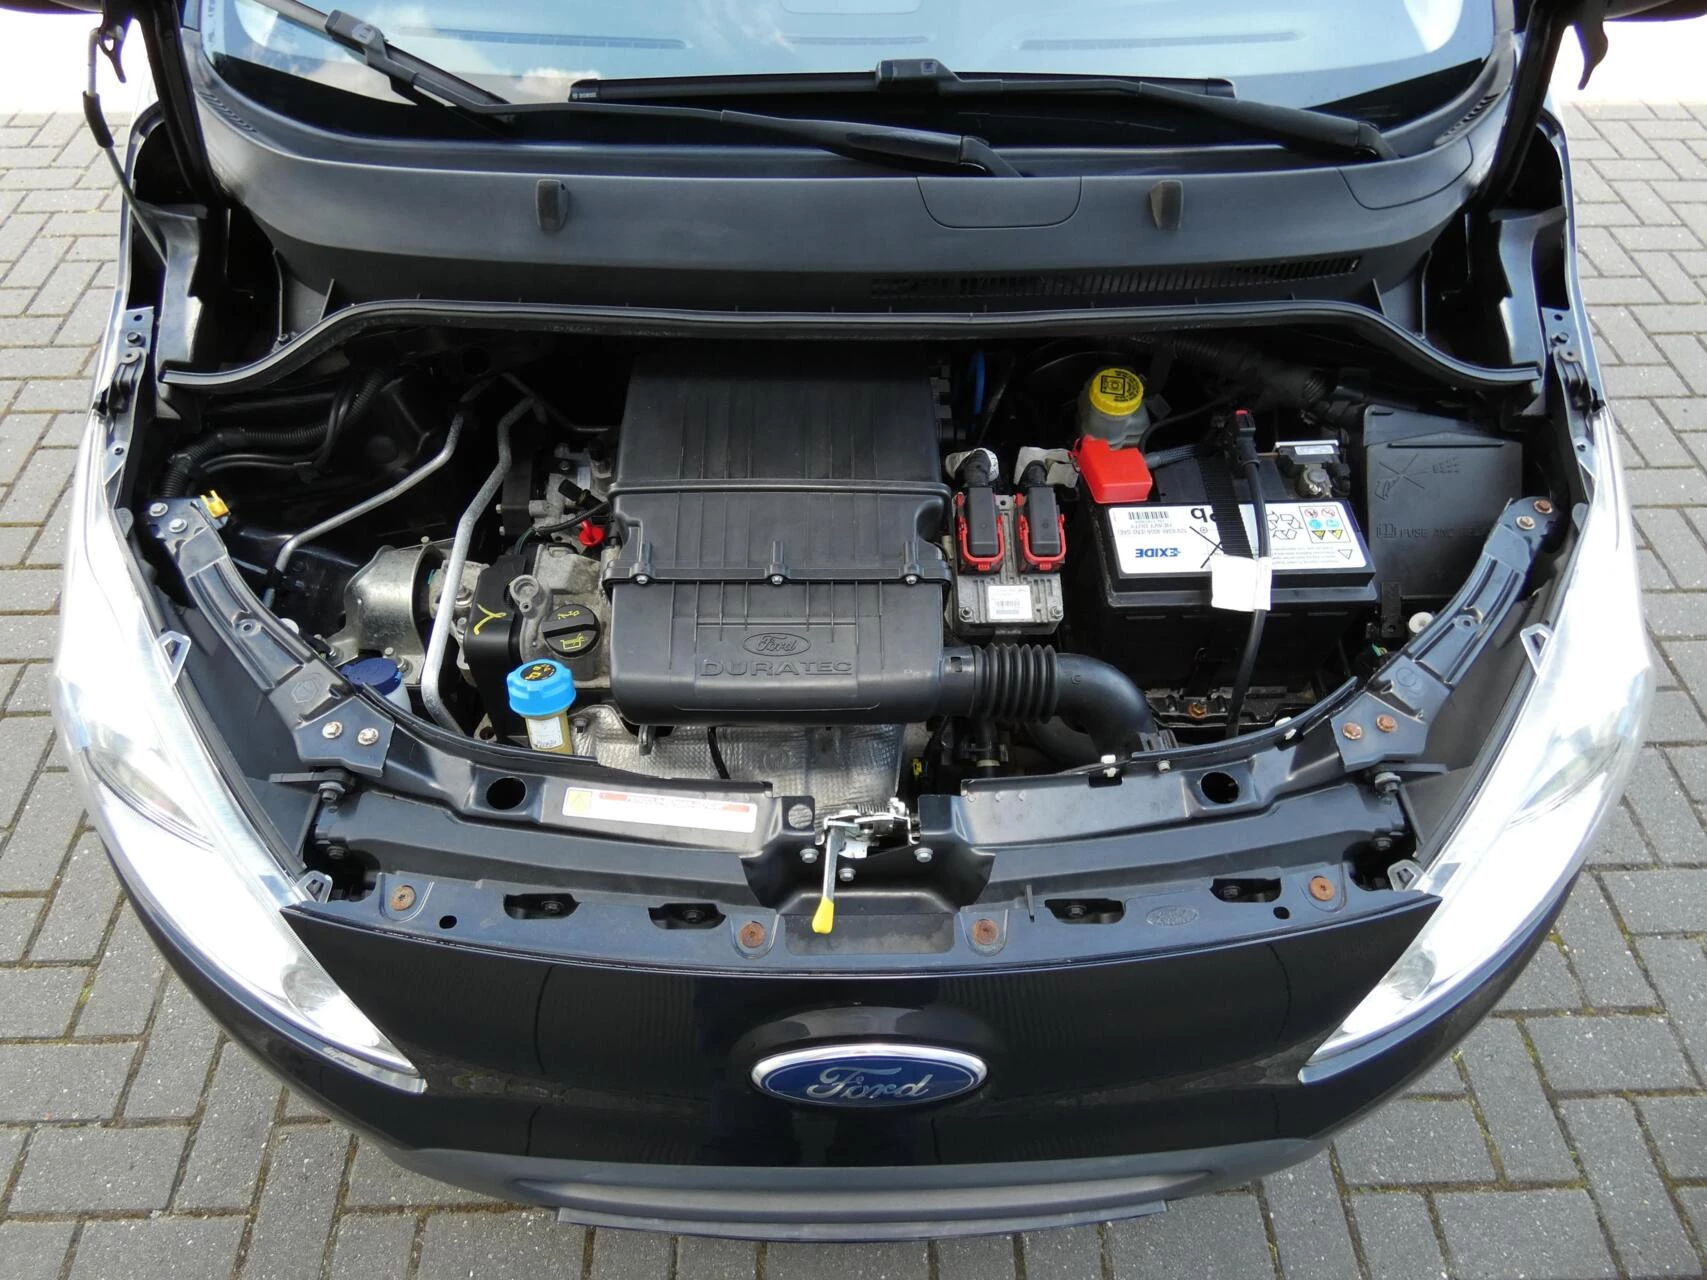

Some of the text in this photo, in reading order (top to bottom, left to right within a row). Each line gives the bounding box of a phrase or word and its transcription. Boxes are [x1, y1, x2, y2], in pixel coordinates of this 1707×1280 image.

[1135, 548, 1181, 558] EXIDE
[756, 635, 797, 652] Ford
[700, 661, 853, 676] DURATEC
[806, 1067, 933, 1099] Ford
